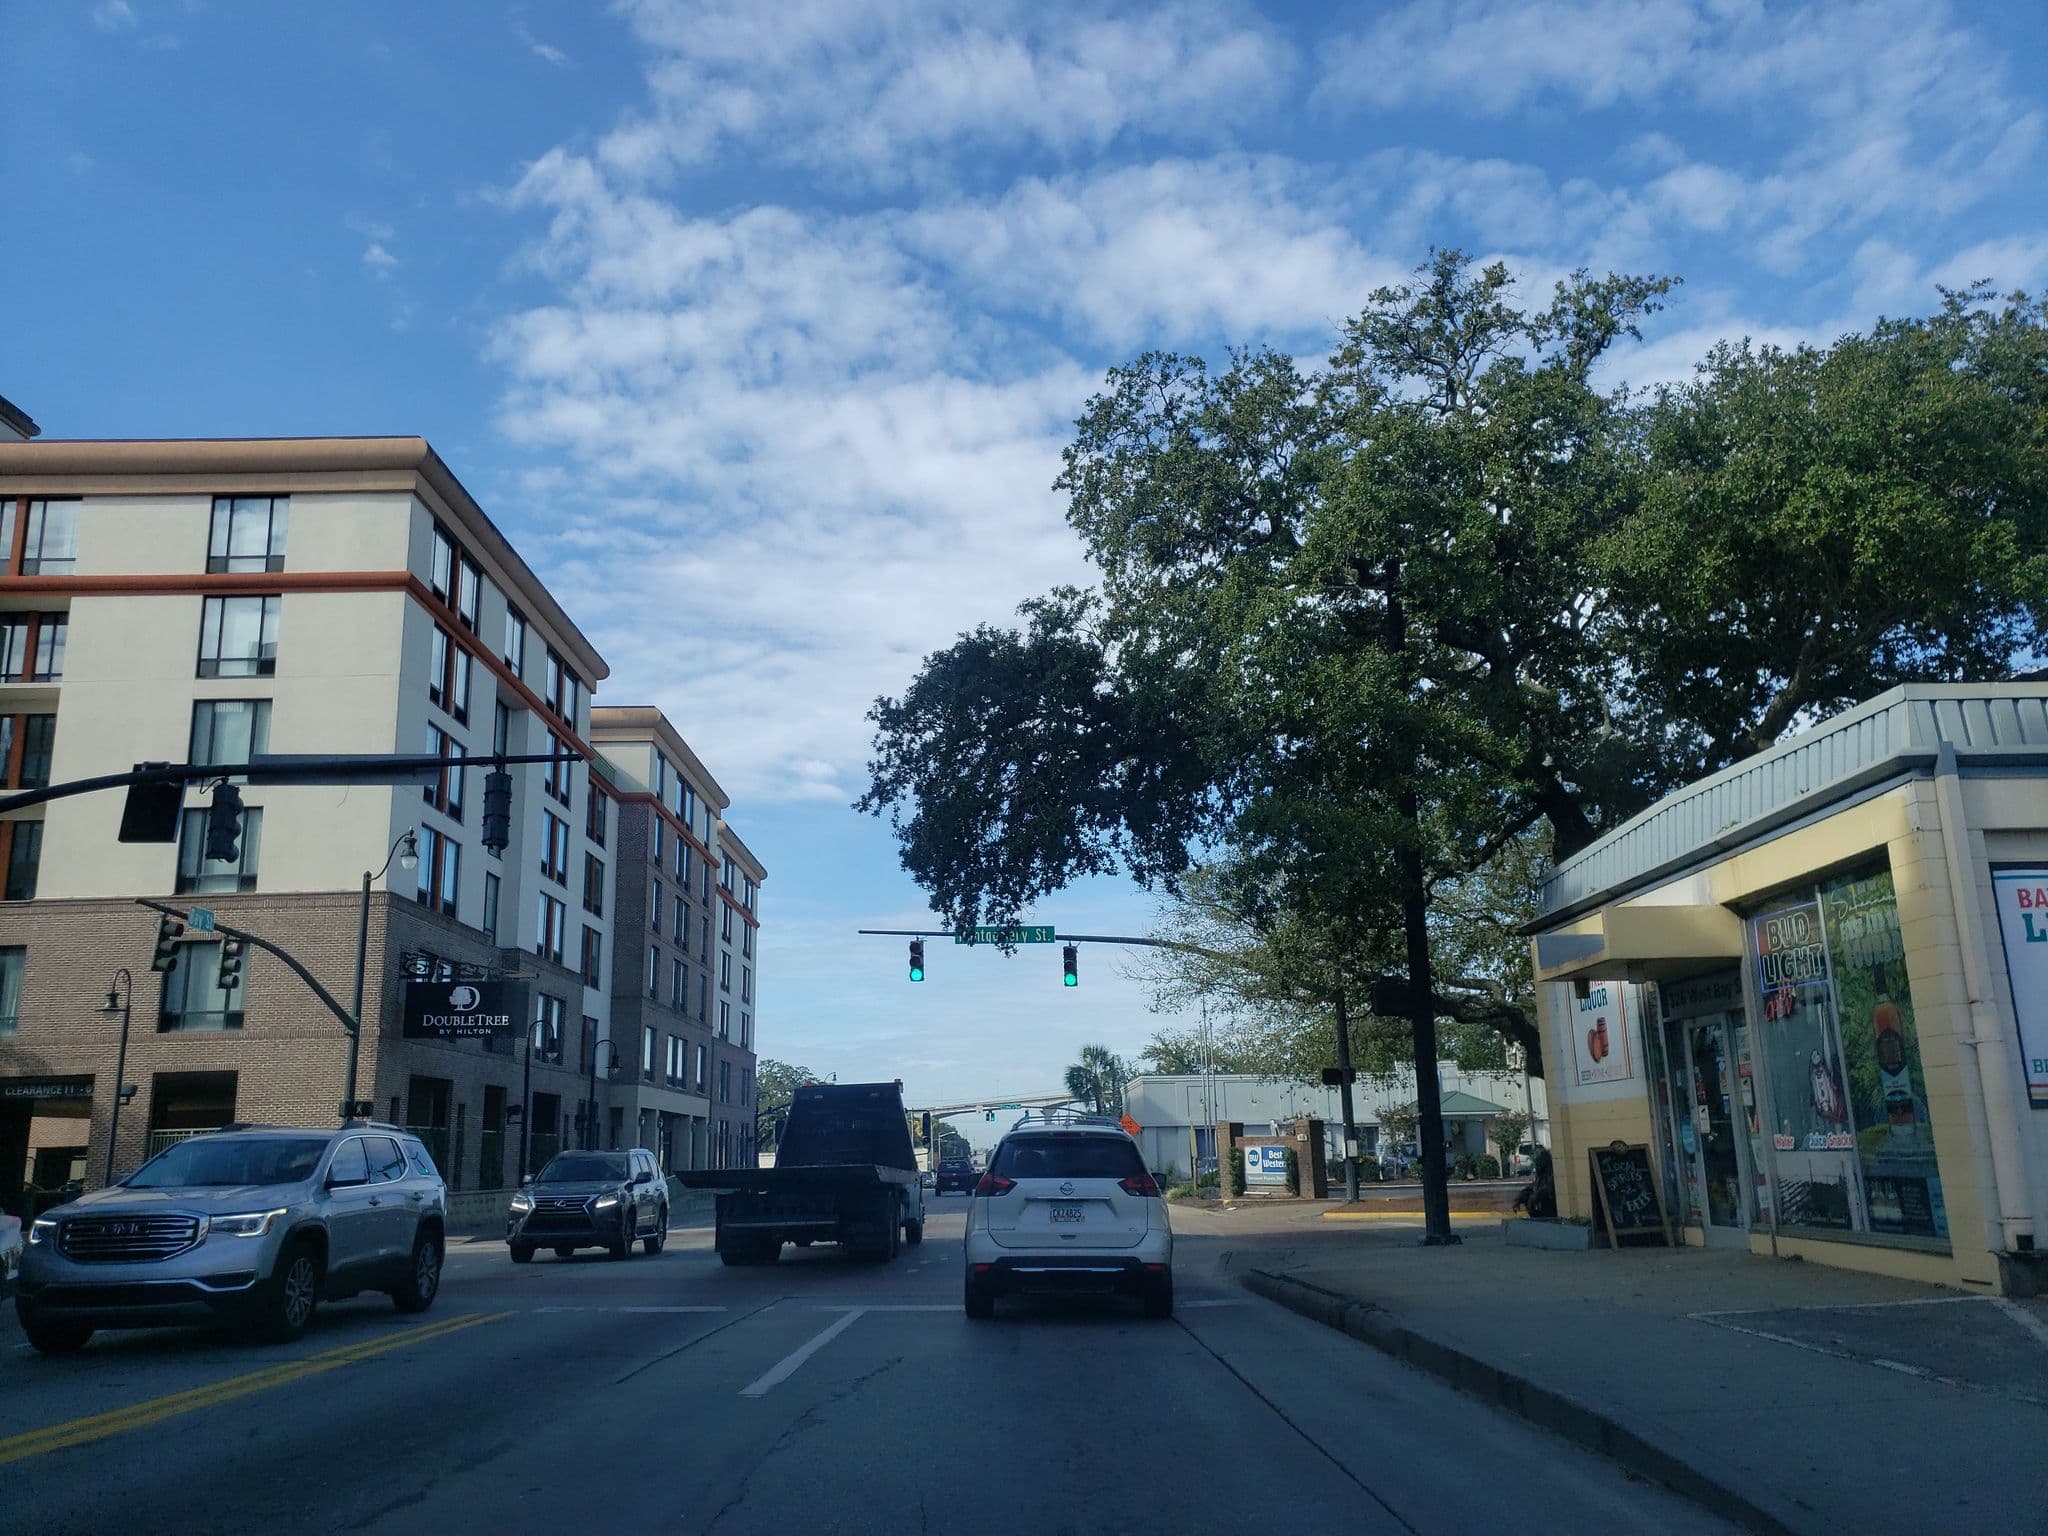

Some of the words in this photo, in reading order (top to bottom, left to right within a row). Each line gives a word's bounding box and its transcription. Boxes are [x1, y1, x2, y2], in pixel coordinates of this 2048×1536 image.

[2017, 888, 2048, 910] BA
[1035, 928, 1051, 941] St.
[1766, 912, 1810, 951] BUD
[2022, 911, 2048, 943] L
[1762, 944, 1824, 985] LIGHT
[1580, 988, 1608, 1012] LIQUOR
[422, 1014, 510, 1027] DOUBLETREE
[5, 1085, 62, 1096] CLEARANCE
[1268, 1150, 1283, 1160] Best
